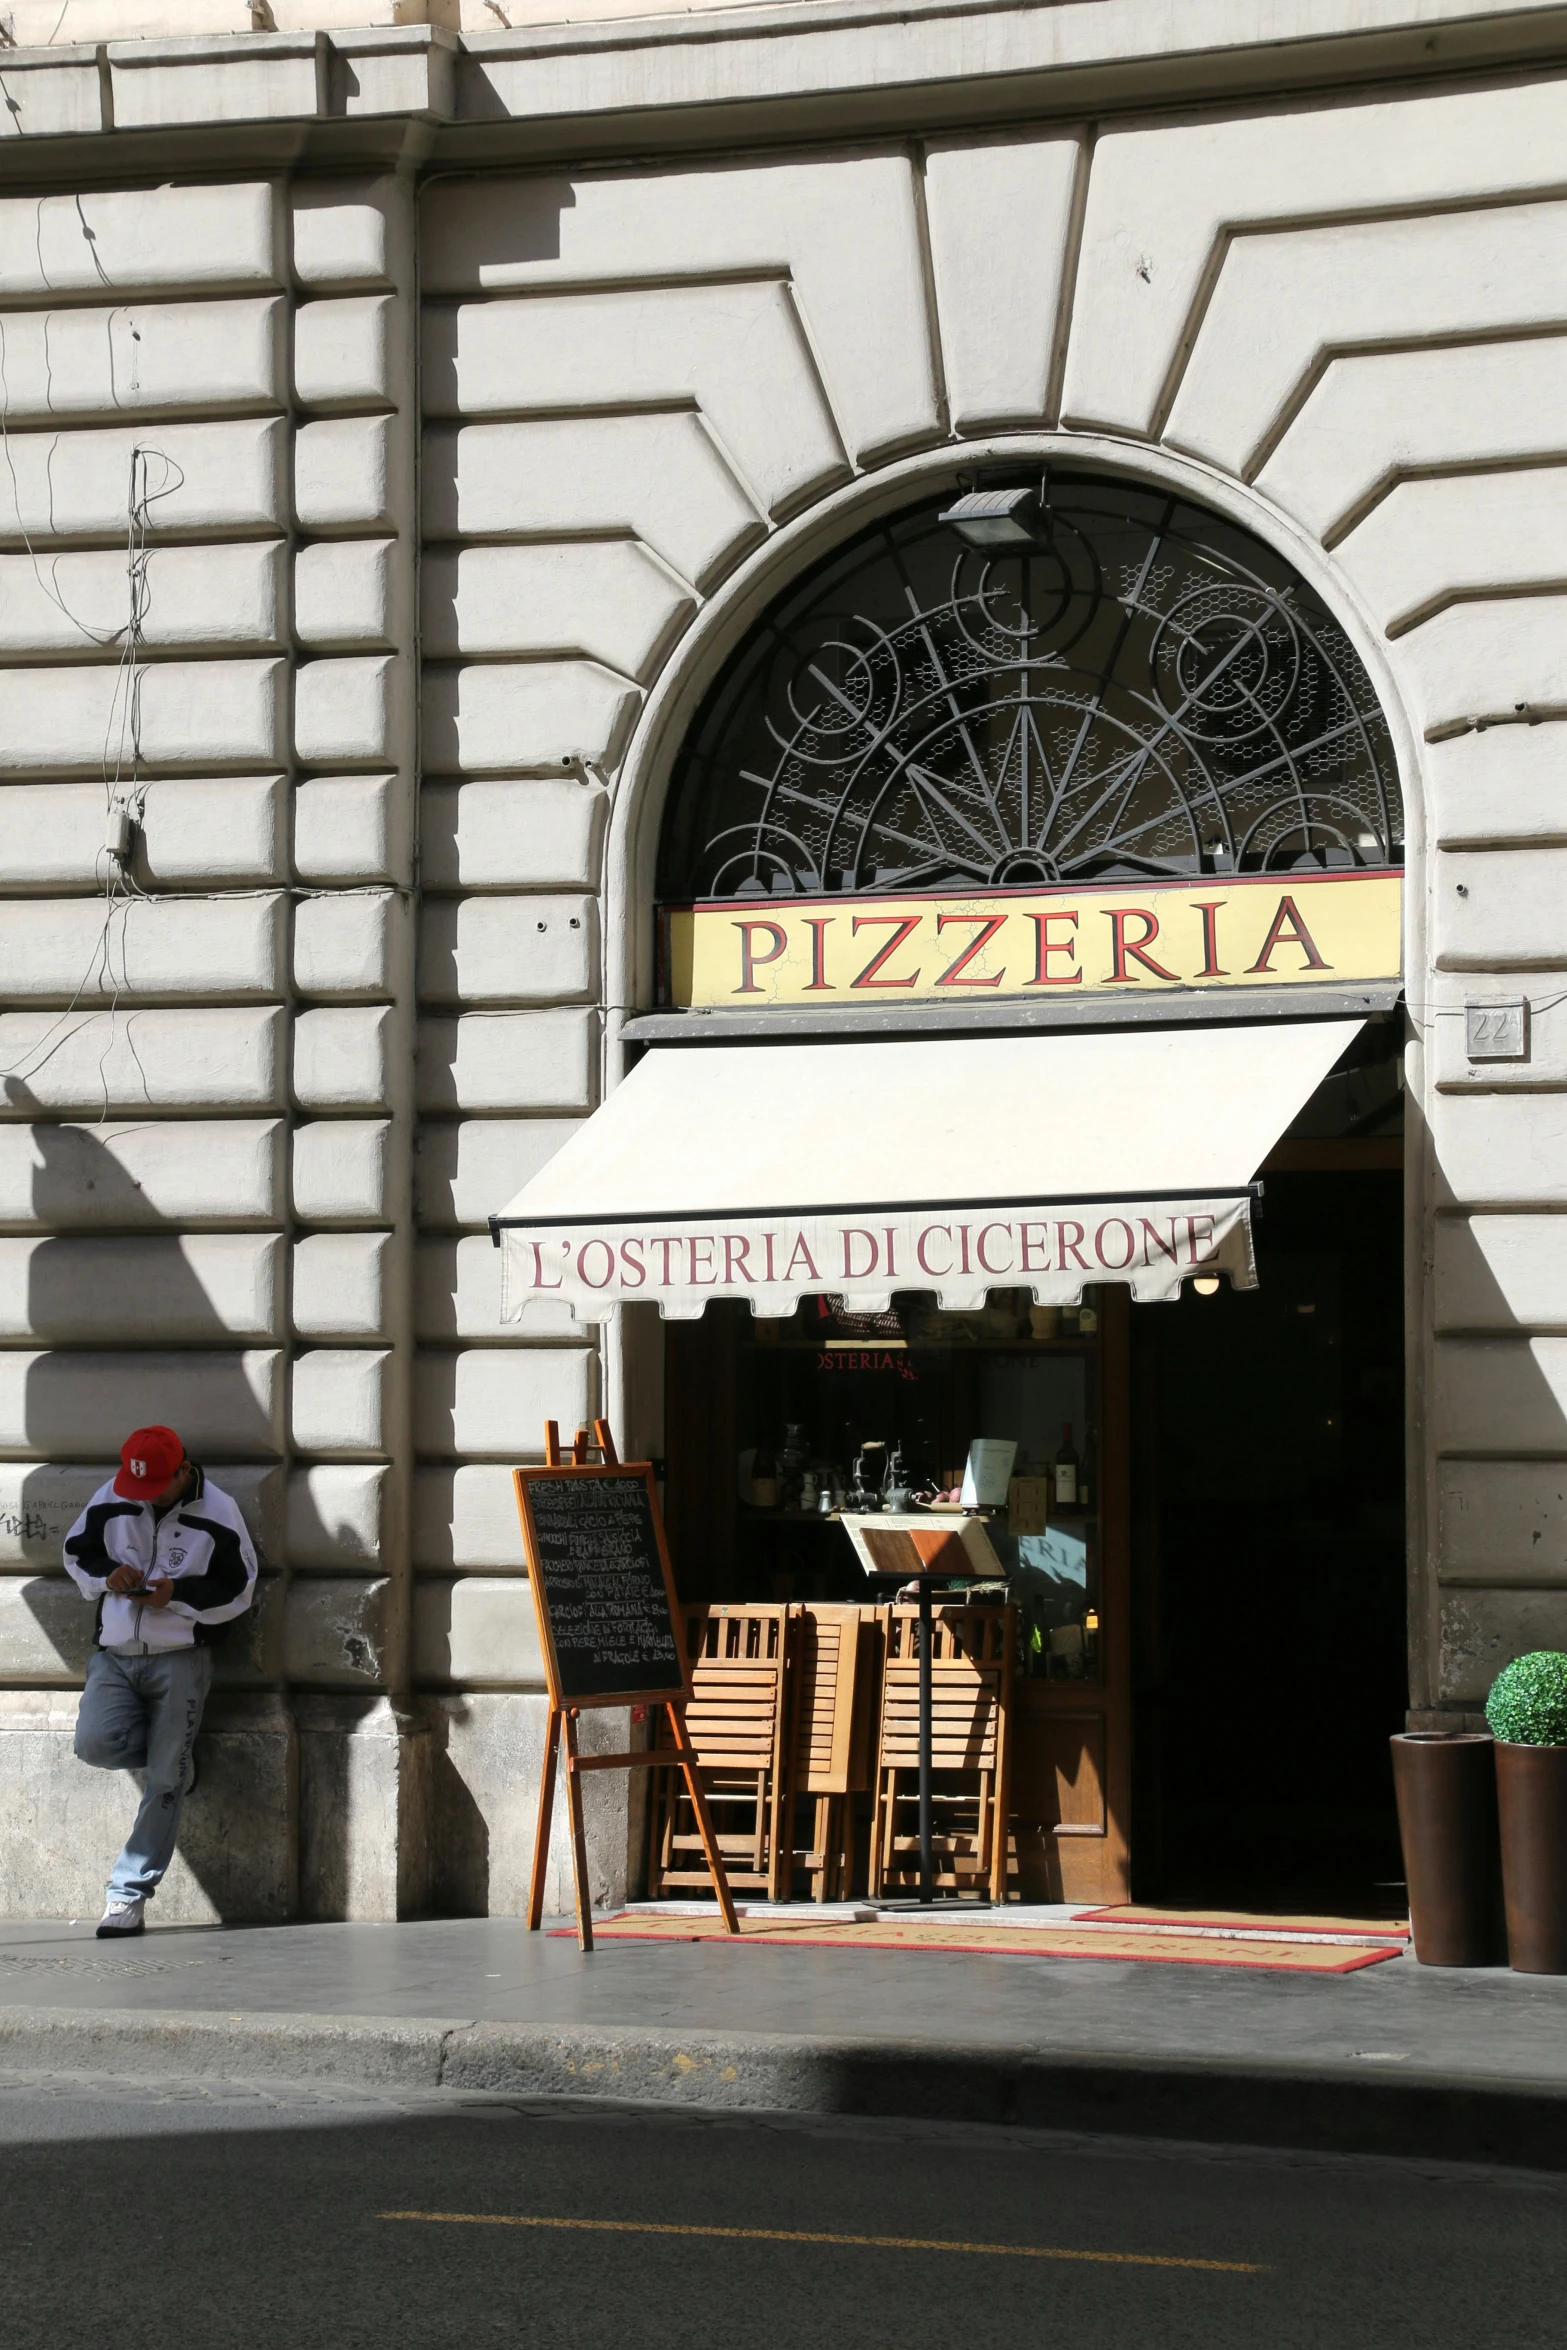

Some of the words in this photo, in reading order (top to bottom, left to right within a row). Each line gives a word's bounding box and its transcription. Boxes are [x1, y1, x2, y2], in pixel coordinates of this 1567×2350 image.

[731, 895, 1334, 994] PIZZERIA
[528, 1230, 821, 1290] L'OSTERIA
[838, 1225, 901, 1280] DI
[916, 1213, 1222, 1277] CICERONE
[528, 1481, 564, 1495] FRESH
[565, 1478, 603, 1492] PASTA
